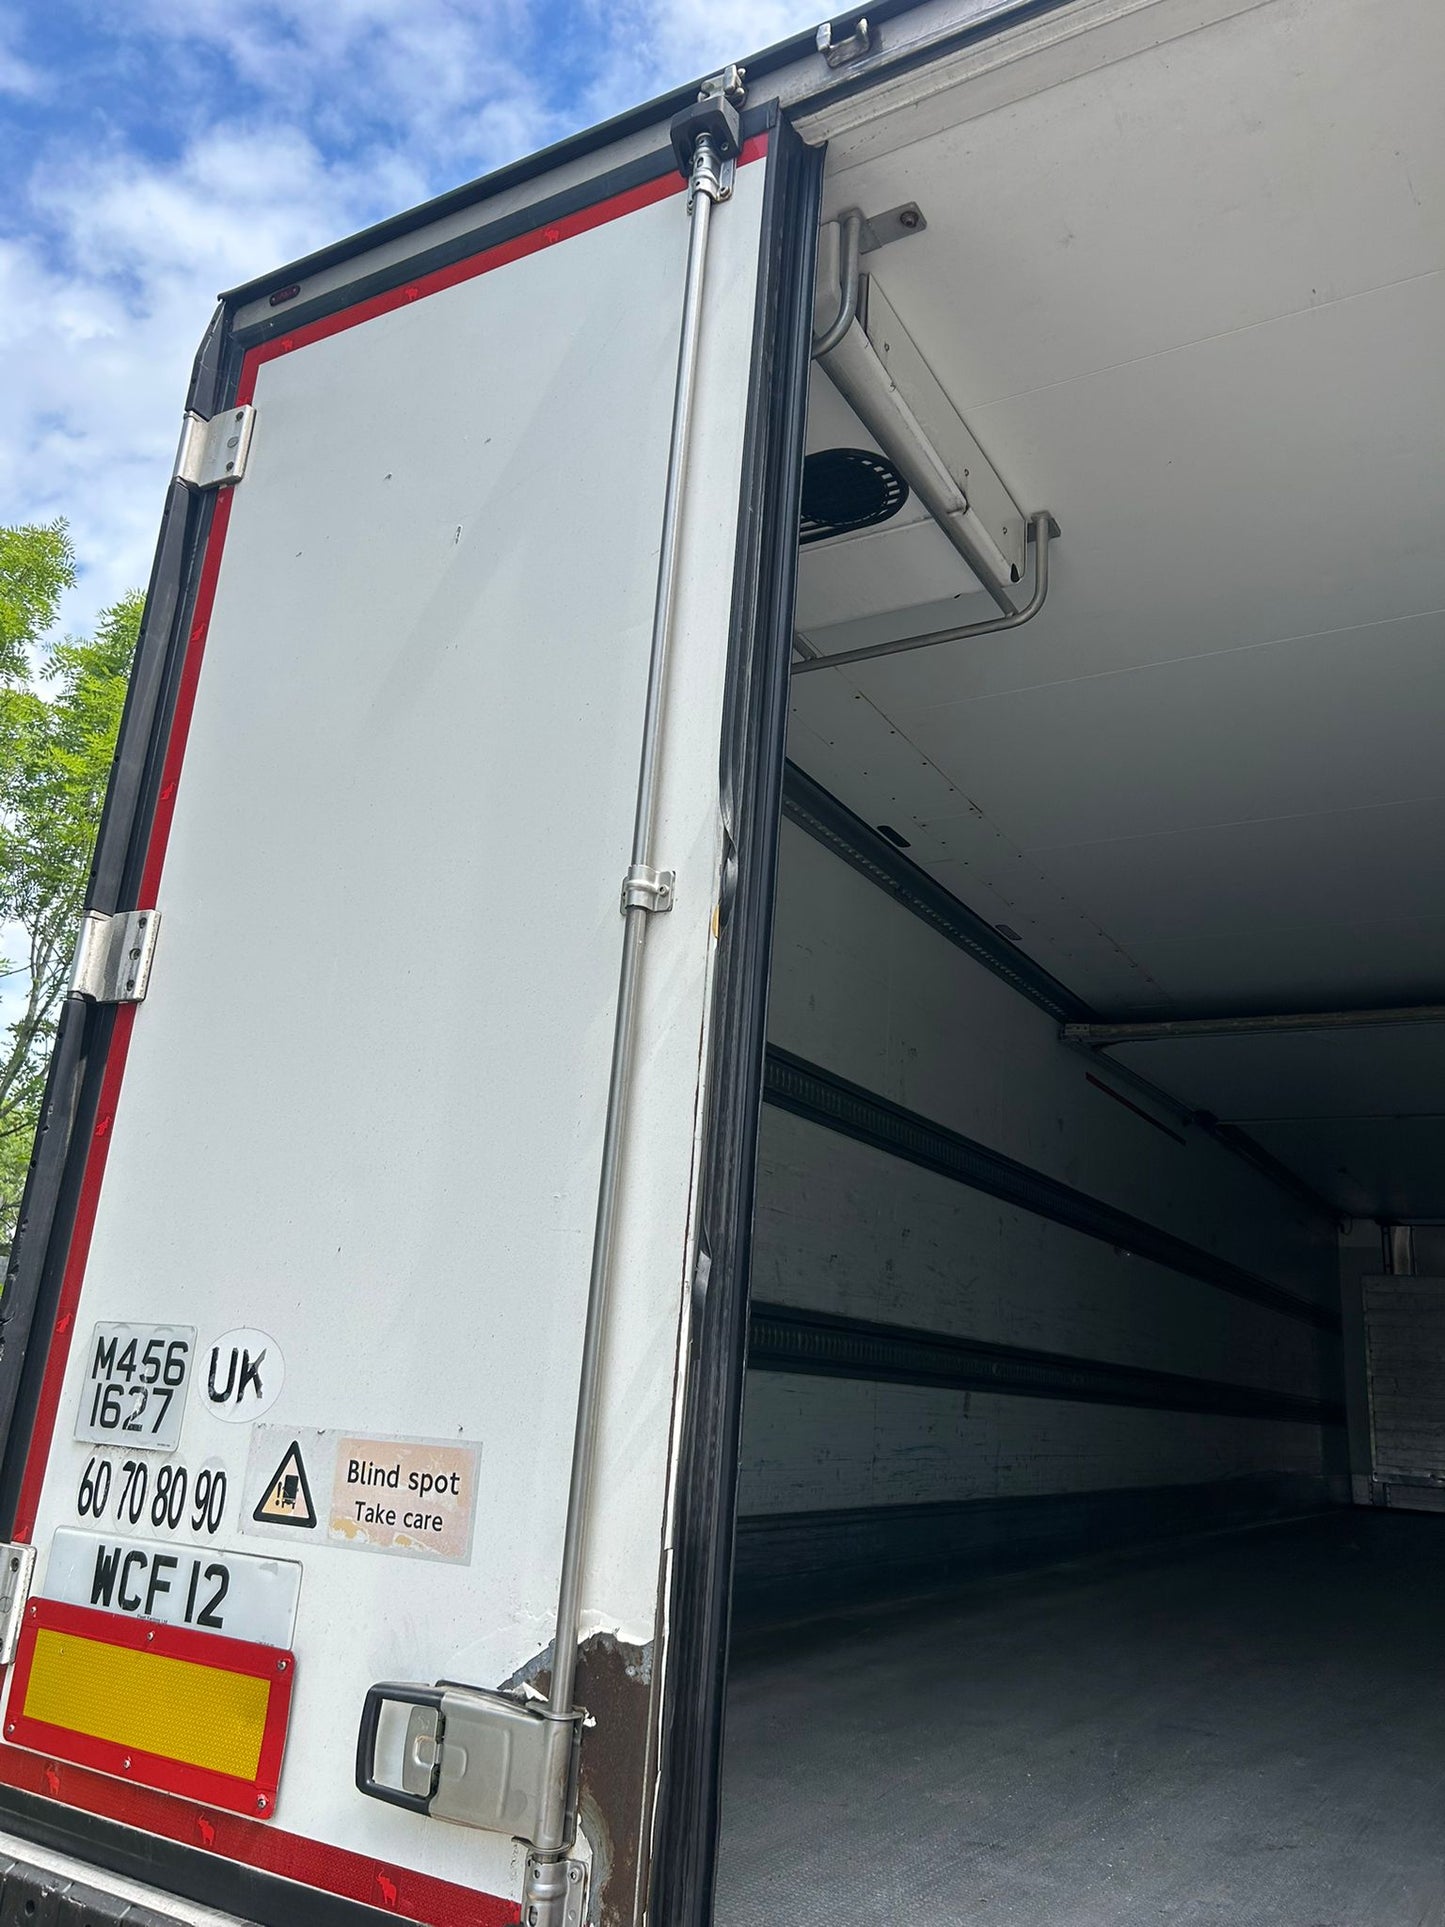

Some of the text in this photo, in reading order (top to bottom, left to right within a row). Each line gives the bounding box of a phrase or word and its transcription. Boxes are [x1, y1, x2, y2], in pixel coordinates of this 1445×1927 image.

[92, 1336, 188, 1386] M456
[207, 1346, 267, 1403] UK
[90, 1383, 174, 1433] 1627
[77, 1457, 227, 1534] 60 70 80 90
[347, 1460, 460, 1498] Blind spot
[355, 1501, 443, 1532] Take care
[90, 1545, 230, 1629] WCF 12
